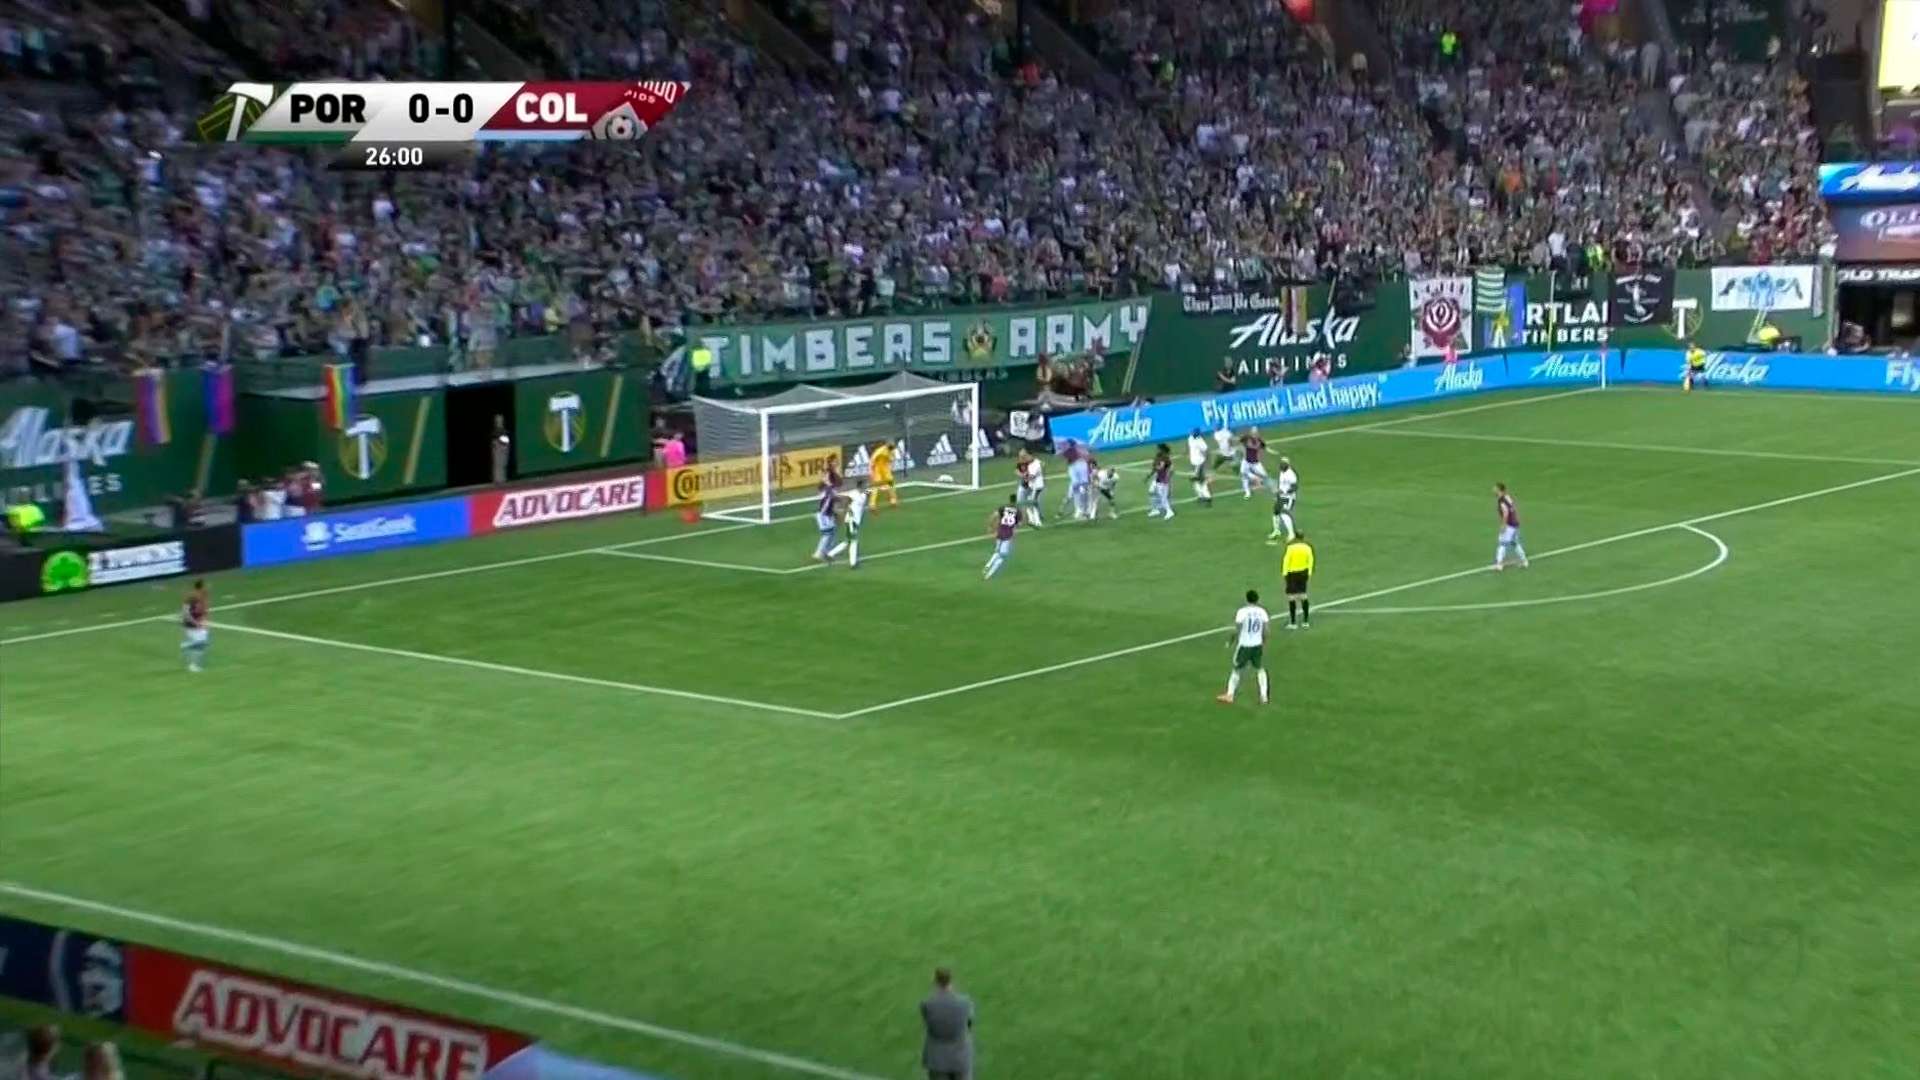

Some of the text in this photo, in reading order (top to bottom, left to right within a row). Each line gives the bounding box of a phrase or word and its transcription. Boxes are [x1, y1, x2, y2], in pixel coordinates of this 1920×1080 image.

[1523, 301, 1608, 325] RTLA
[701, 304, 1147, 379] TIMBERS ARMY
[1237, 353, 1348, 376] AILIS
[1434, 361, 1484, 393] Alaska
[1530, 353, 1601, 380] Alaska
[1202, 399, 1229, 429] Fly
[1232, 393, 1285, 421] smart.
[1287, 383, 1327, 413] Land
[1088, 410, 1152, 445] Alaska
[674, 455, 827, 500] Continentl TIR
[496, 477, 643, 524] ADVOCARE
[178, 977, 486, 1080] ADVOCARE
